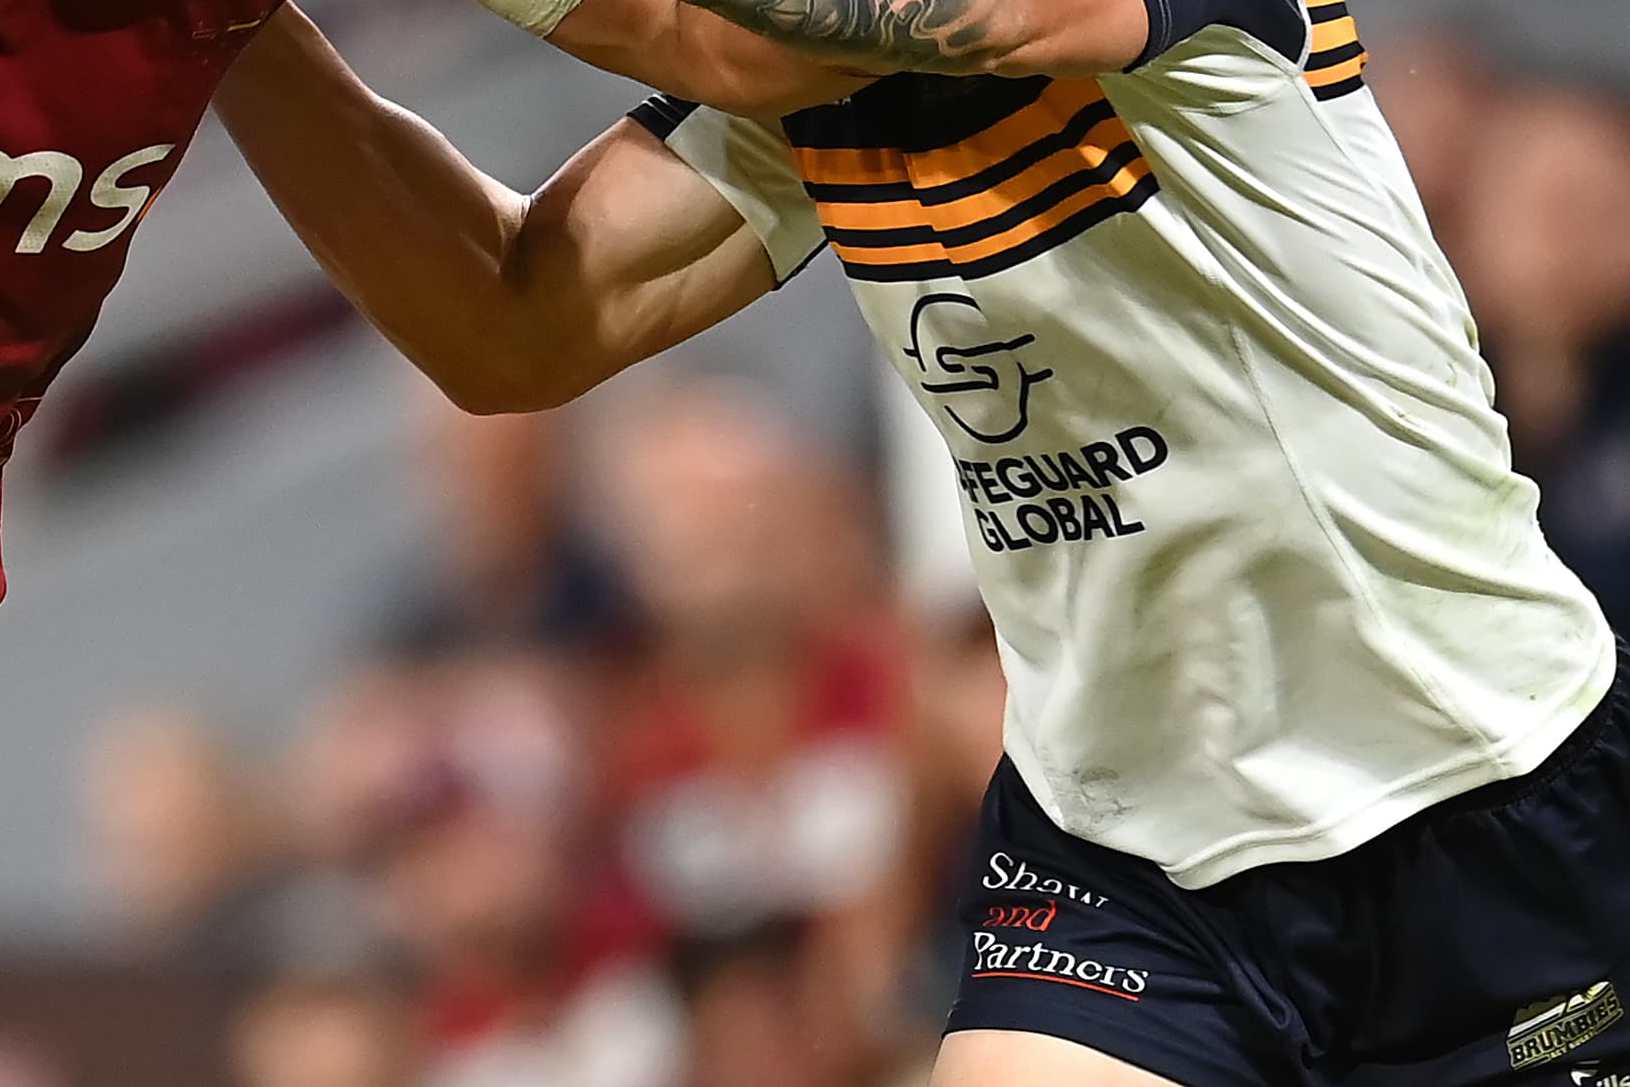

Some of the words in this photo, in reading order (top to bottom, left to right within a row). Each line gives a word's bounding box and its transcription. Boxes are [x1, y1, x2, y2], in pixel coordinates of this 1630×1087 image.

[974, 493, 1146, 552] GLOBAL
[982, 899, 1058, 932] and
[973, 931, 1149, 993] Partners
[1511, 995, 1618, 1065] BRUMBIES
